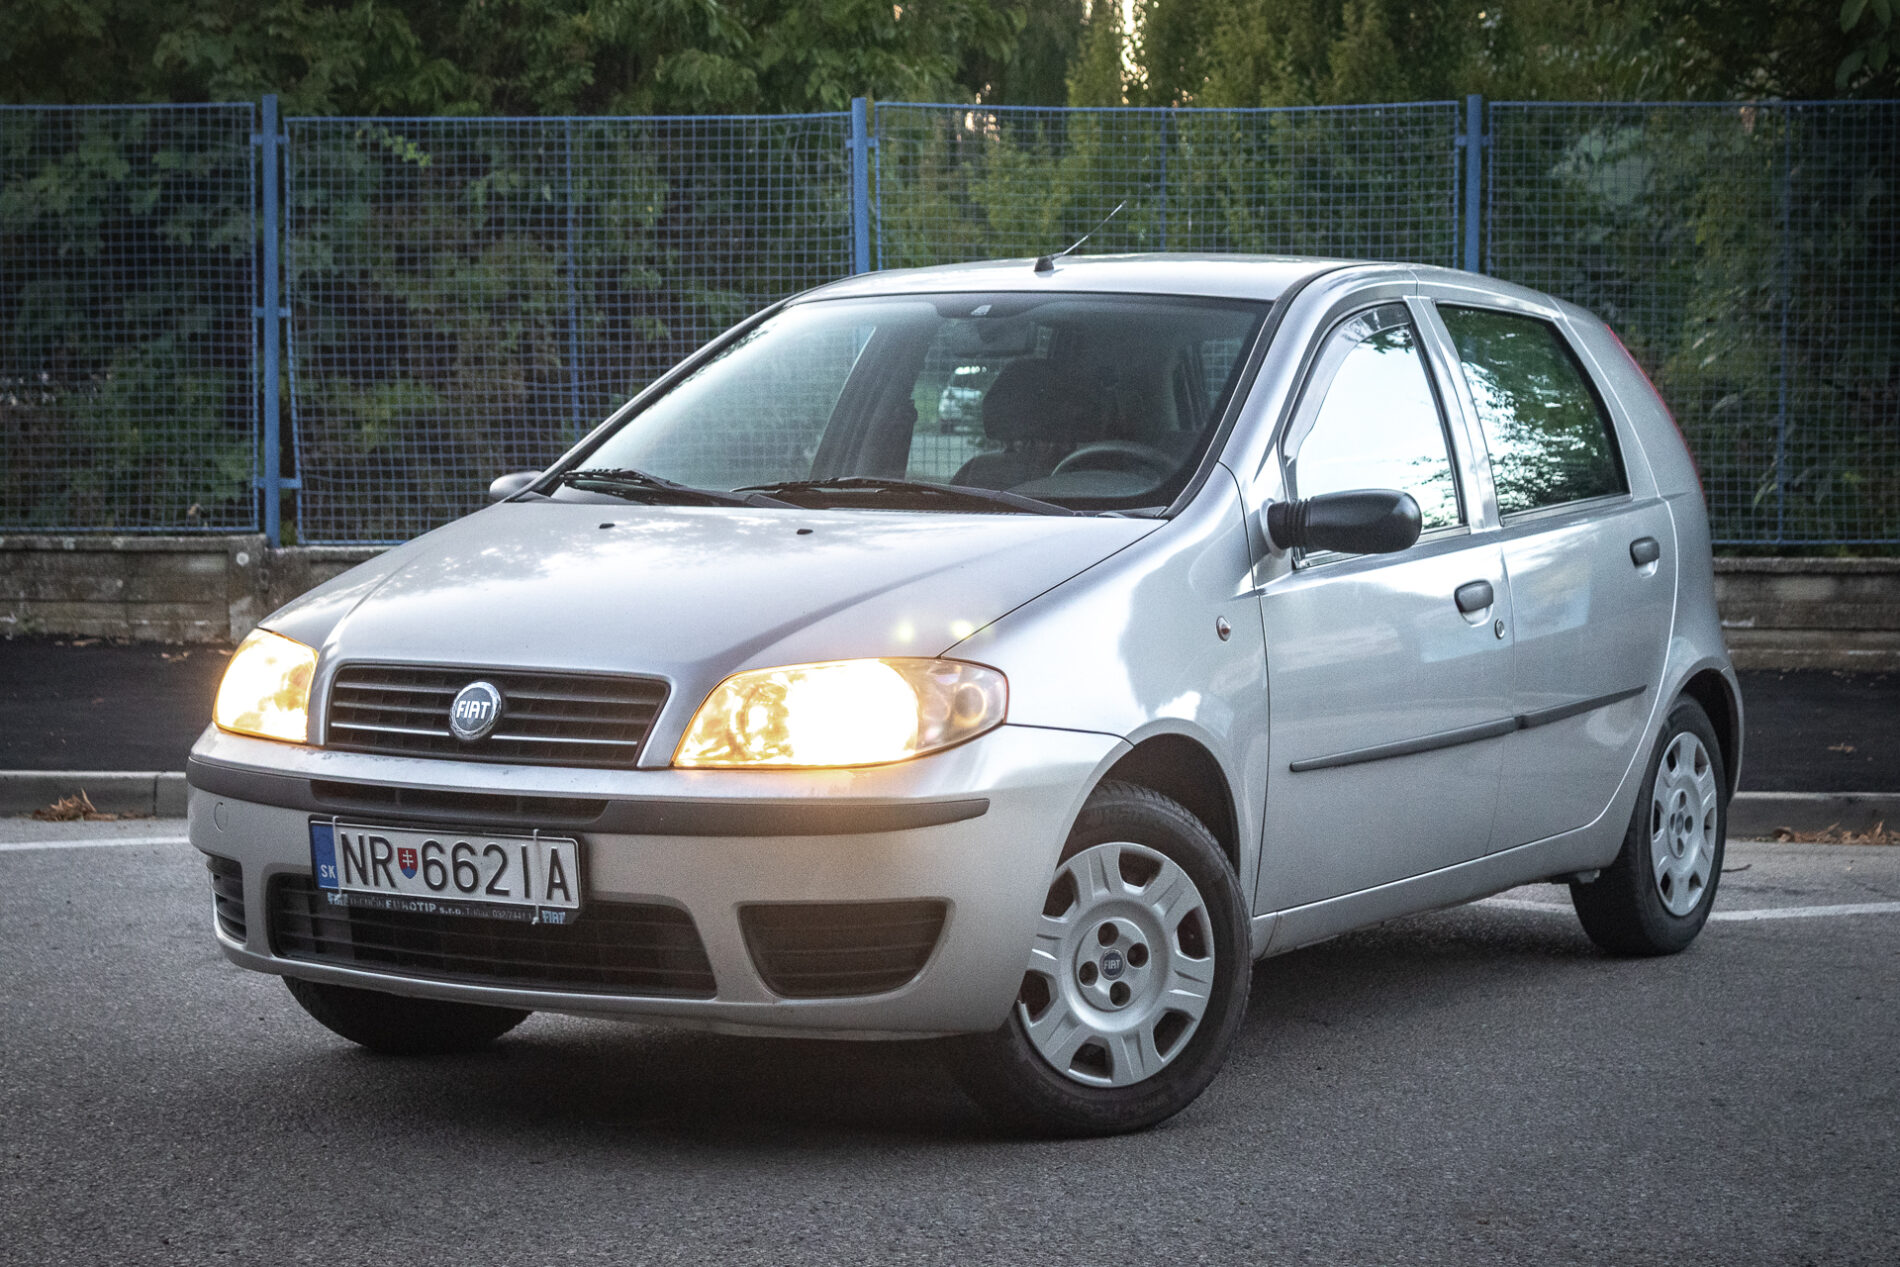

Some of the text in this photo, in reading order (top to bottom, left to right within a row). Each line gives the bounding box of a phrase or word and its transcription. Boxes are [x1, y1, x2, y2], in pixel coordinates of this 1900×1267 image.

[456, 700, 491, 719] FIAT
[340, 831, 397, 889] NR
[321, 864, 337, 879] SK
[542, 910, 566, 926] FIAT
[1103, 959, 1121, 970] FIAT
